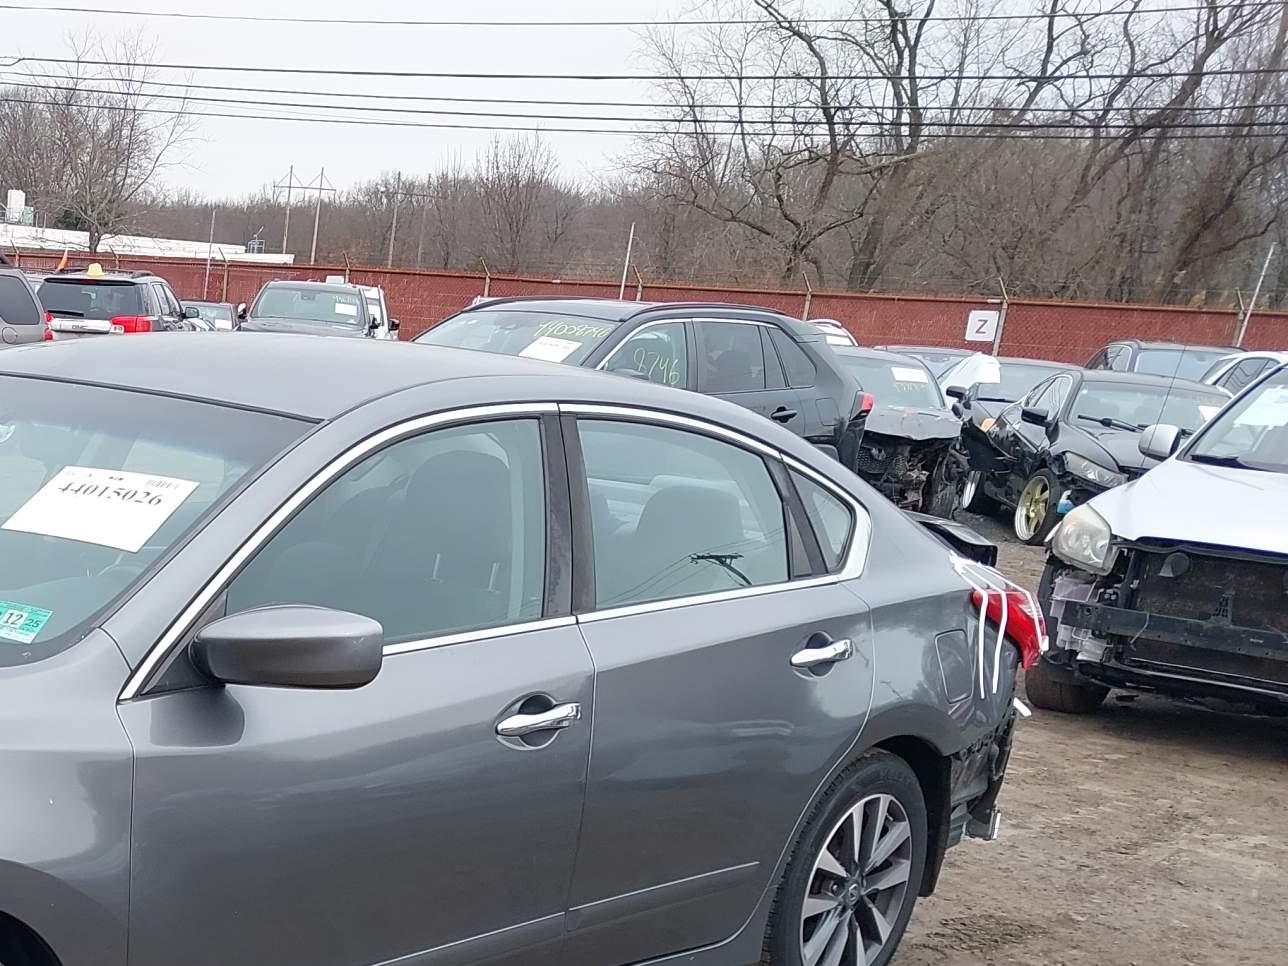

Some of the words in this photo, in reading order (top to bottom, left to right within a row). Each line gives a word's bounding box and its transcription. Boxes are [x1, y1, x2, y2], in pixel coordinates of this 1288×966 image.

[975, 319, 989, 334] Z
[58, 482, 163, 506] 44015026
[3, 612, 24, 625] 12
[24, 618, 40, 628] 25
